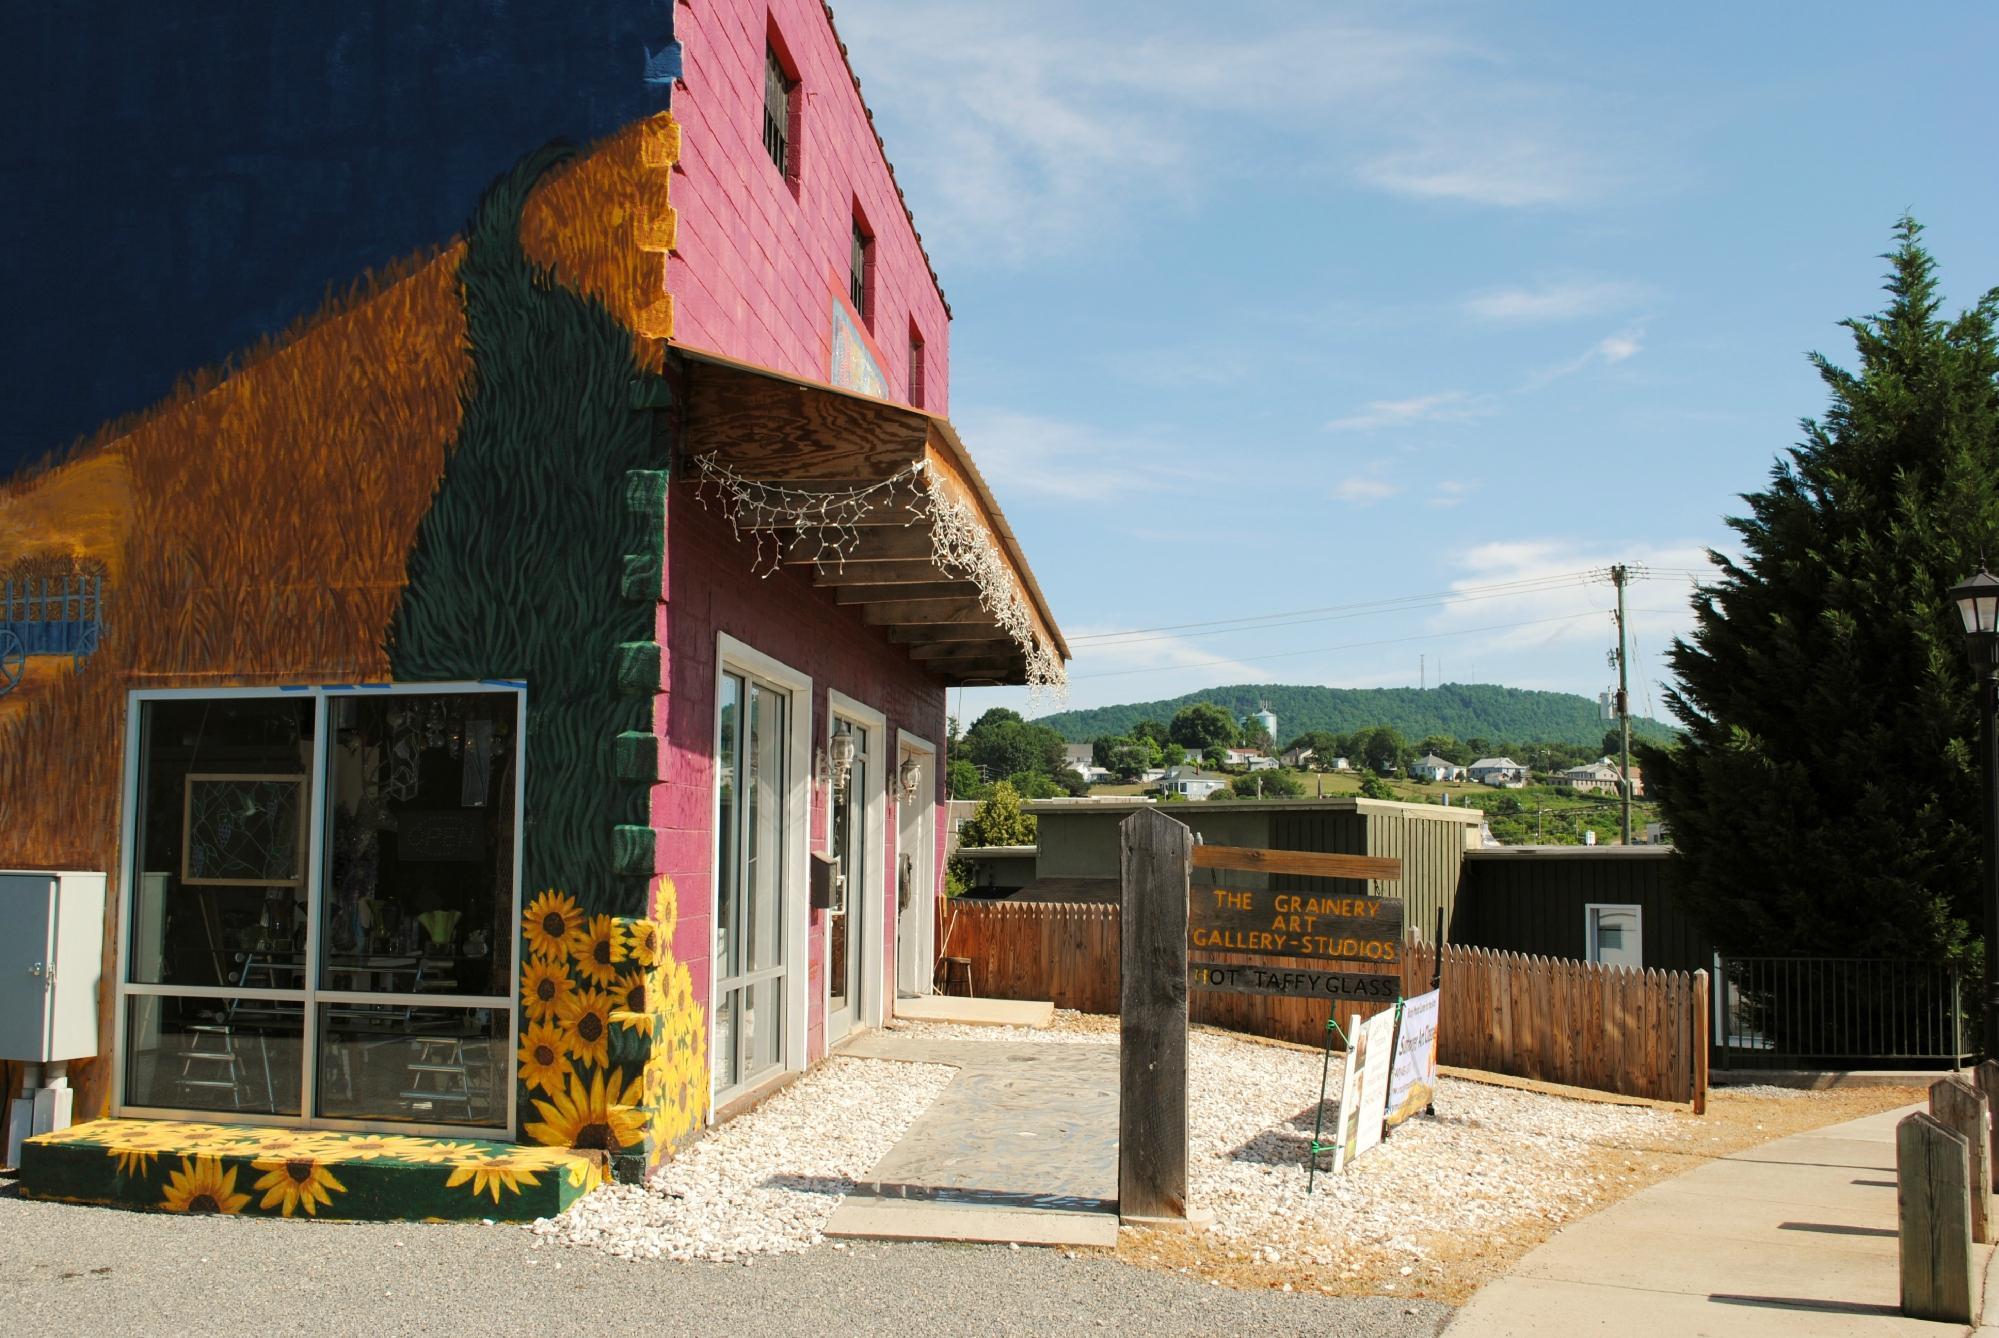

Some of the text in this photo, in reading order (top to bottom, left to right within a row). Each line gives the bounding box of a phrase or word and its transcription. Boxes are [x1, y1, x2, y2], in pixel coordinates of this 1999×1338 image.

[408, 825, 473, 847] OPEN
[1213, 889, 1382, 918] THE GRAINERY
[1271, 915, 1317, 934] ART
[1194, 968, 1393, 997] HOT TAFFY GLASS
